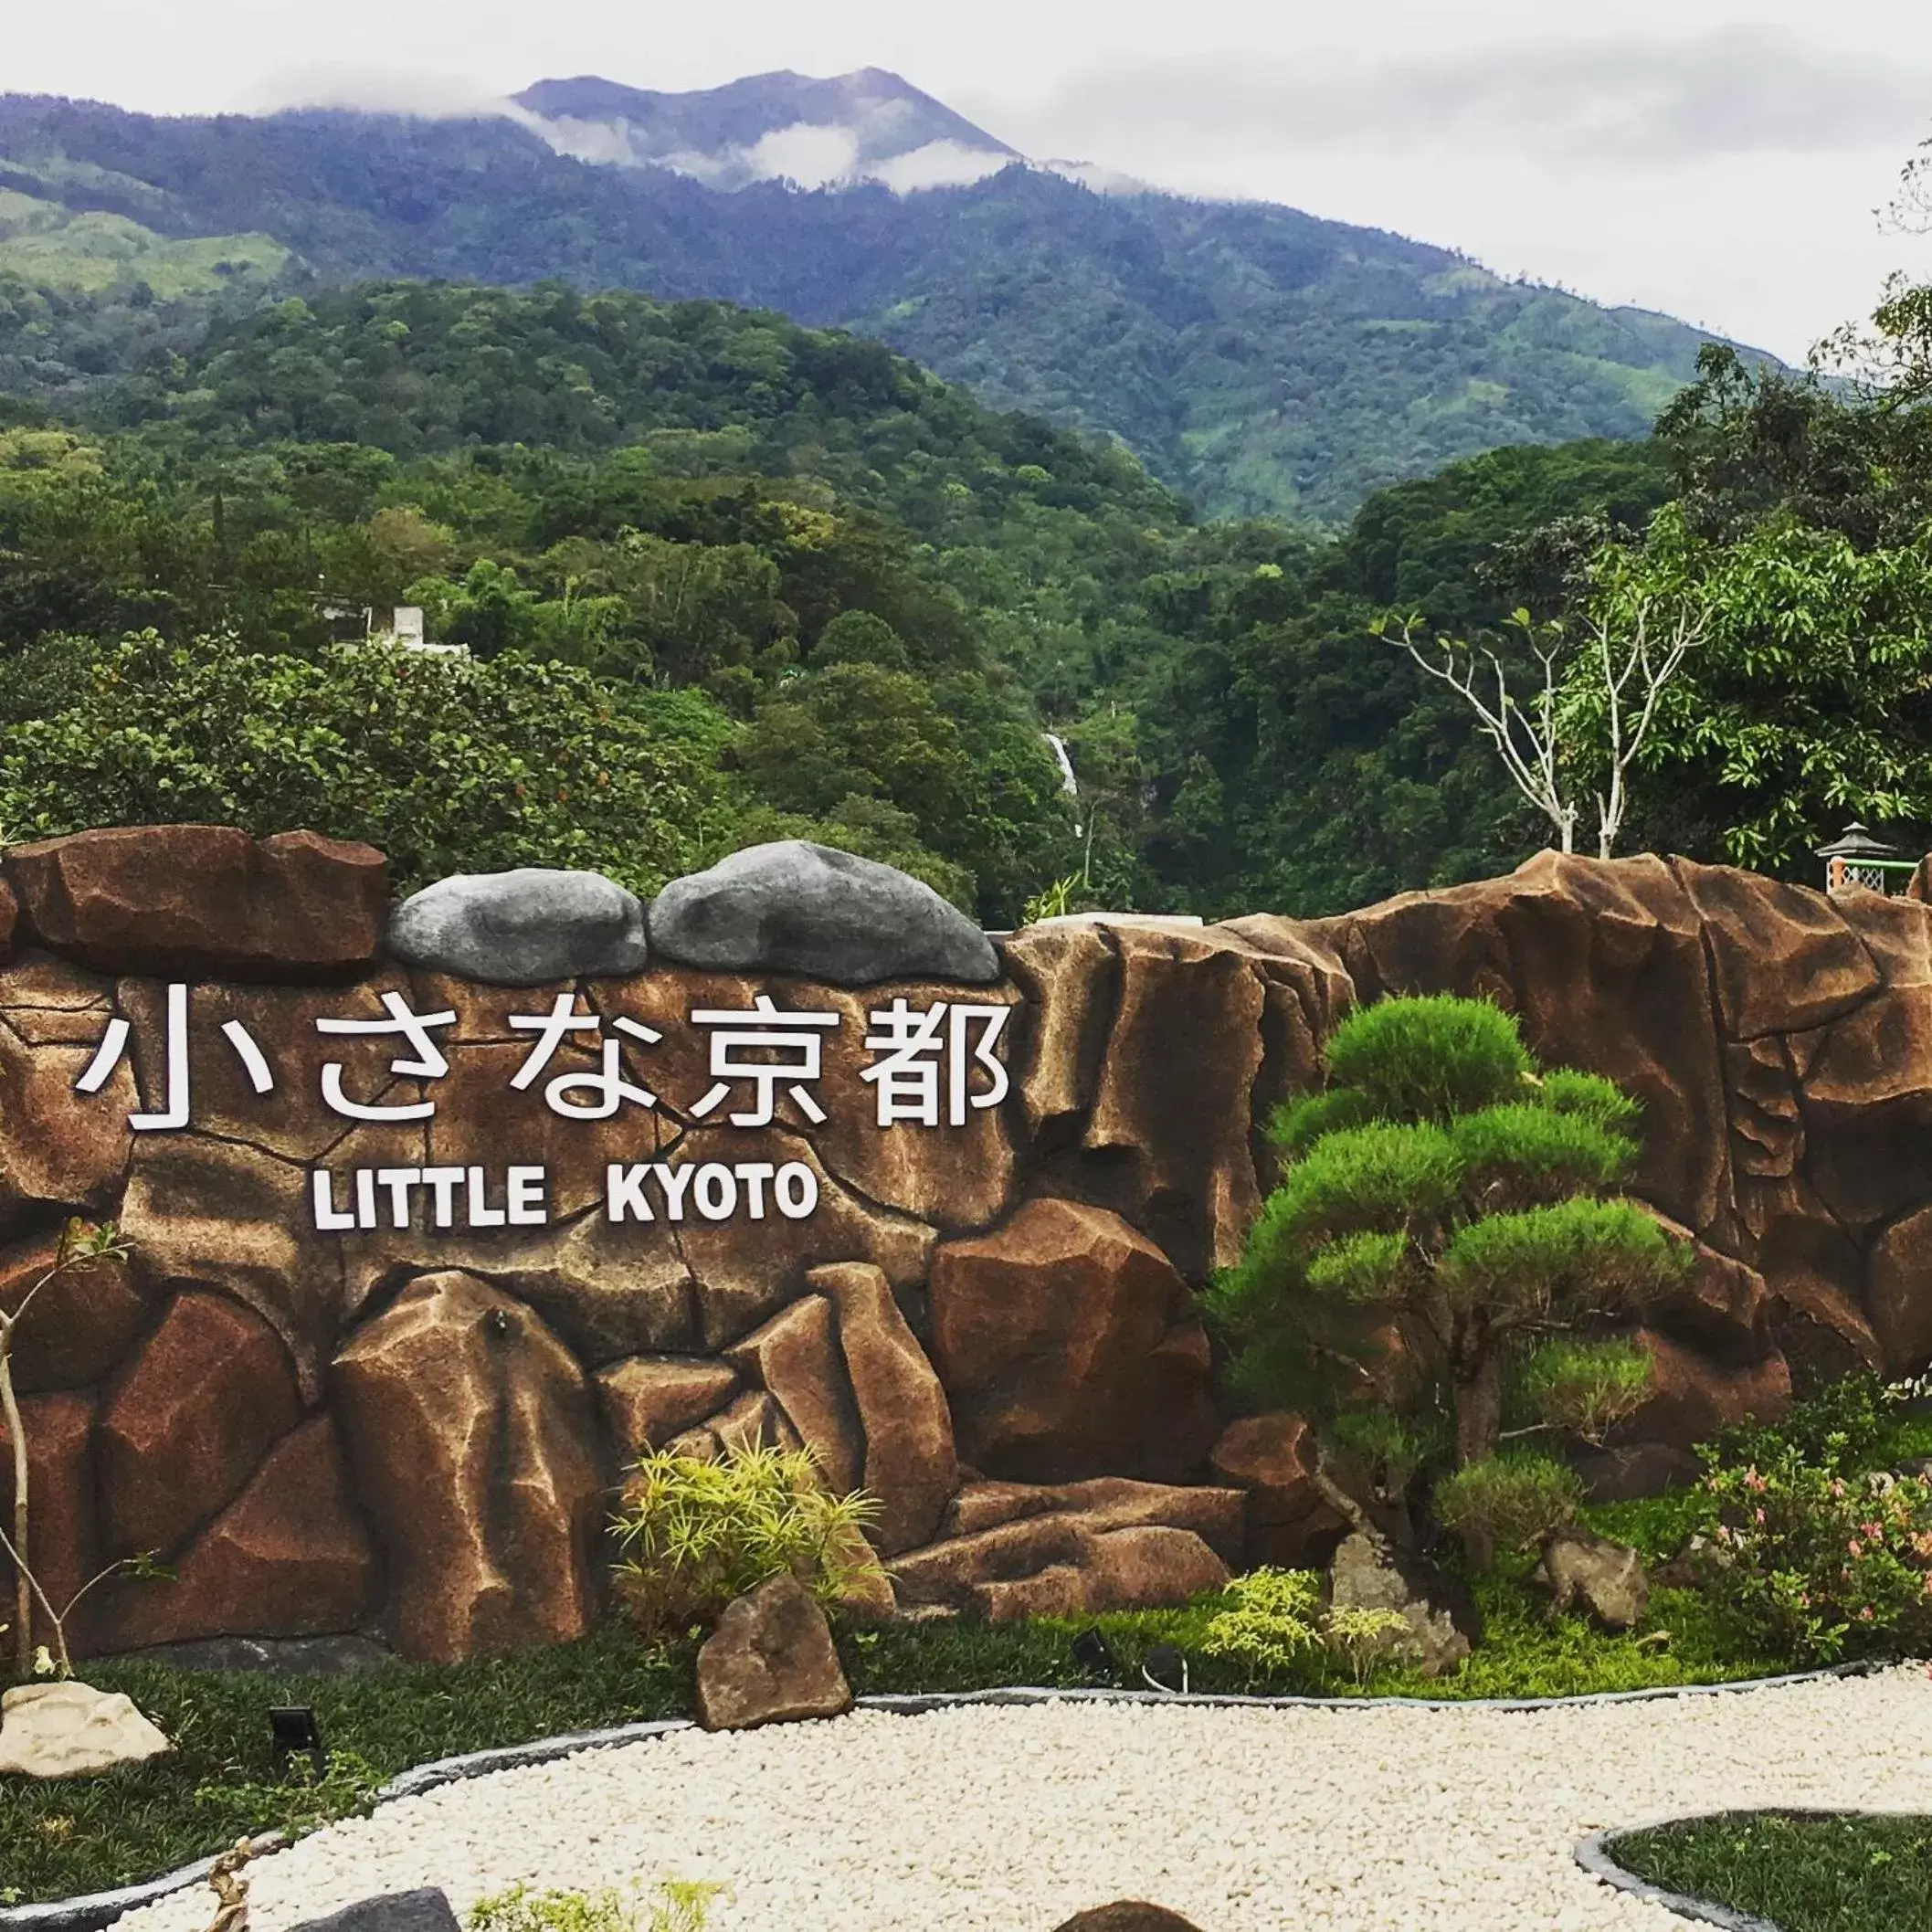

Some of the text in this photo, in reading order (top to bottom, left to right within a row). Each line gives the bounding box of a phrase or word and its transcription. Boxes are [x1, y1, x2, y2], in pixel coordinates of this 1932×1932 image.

[75, 982, 1012, 1131] 小さな京都
[312, 1161, 818, 1230] LITTLE KYOTO
